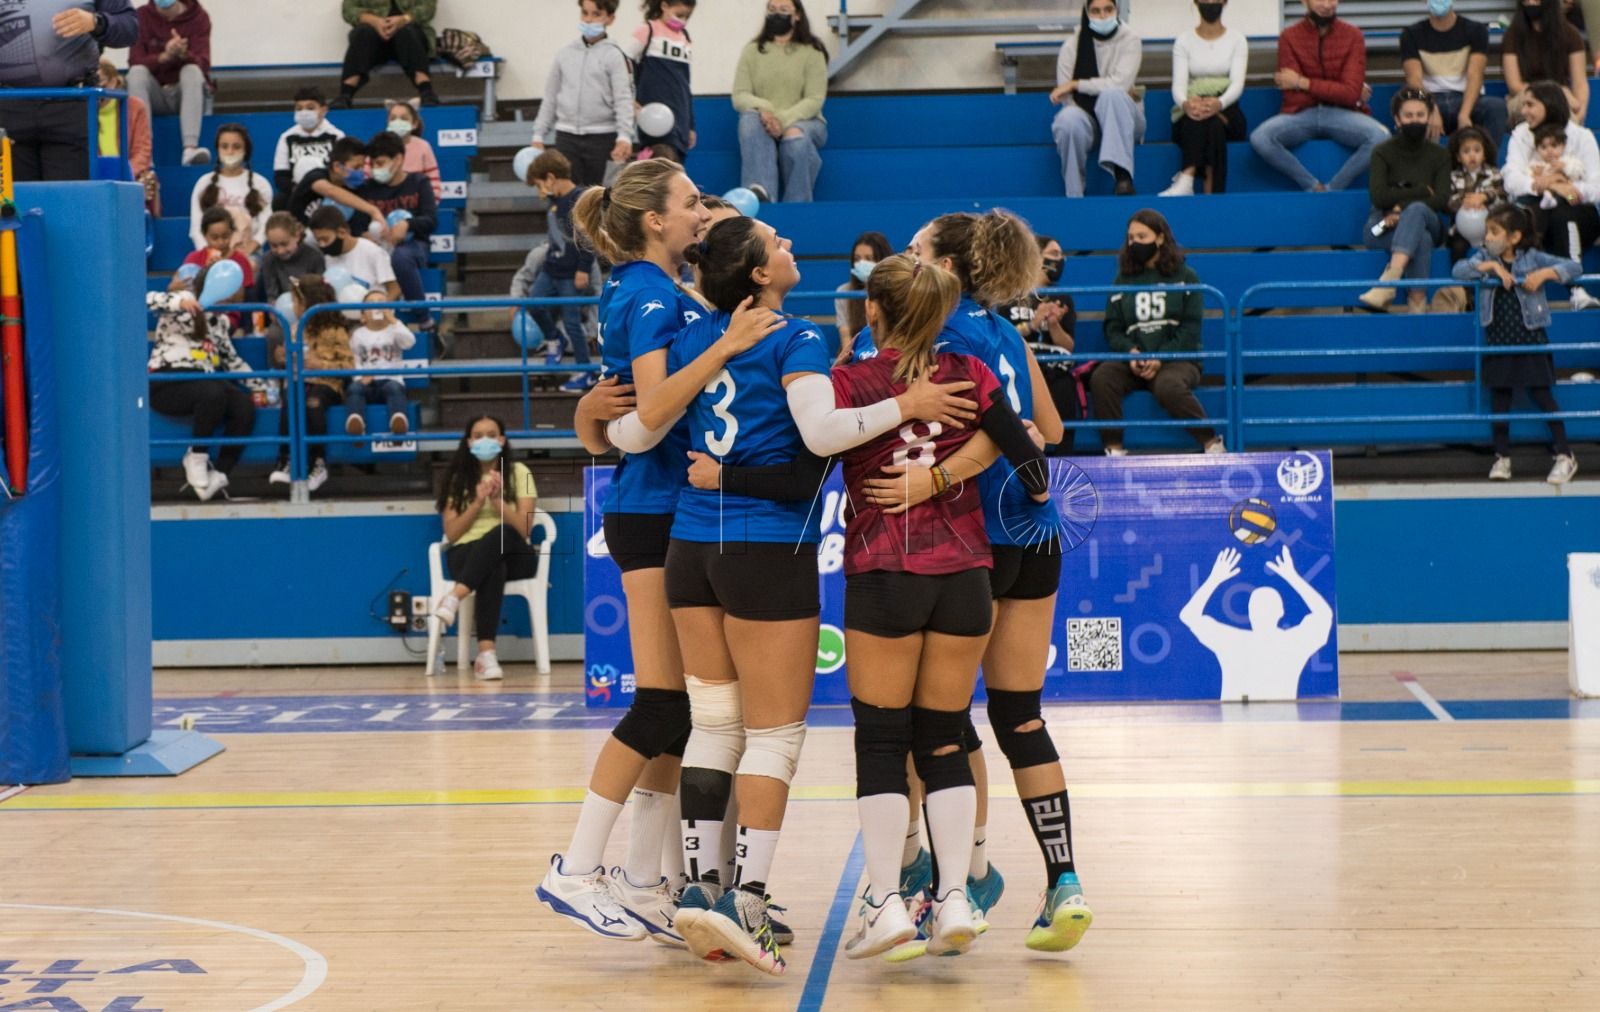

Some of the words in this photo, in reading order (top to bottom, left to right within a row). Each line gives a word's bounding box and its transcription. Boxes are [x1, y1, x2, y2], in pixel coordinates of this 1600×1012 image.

[465, 132, 474, 142] 5
[454, 185, 463, 195] 4
[442, 238, 451, 249] 3
[1135, 291, 1167, 320] 85
[704, 369, 739, 457] 3
[893, 421, 942, 467] 8
[1030, 797, 1071, 864] ELITE
[685, 836, 700, 851] 3
[736, 843, 748, 858] 3
